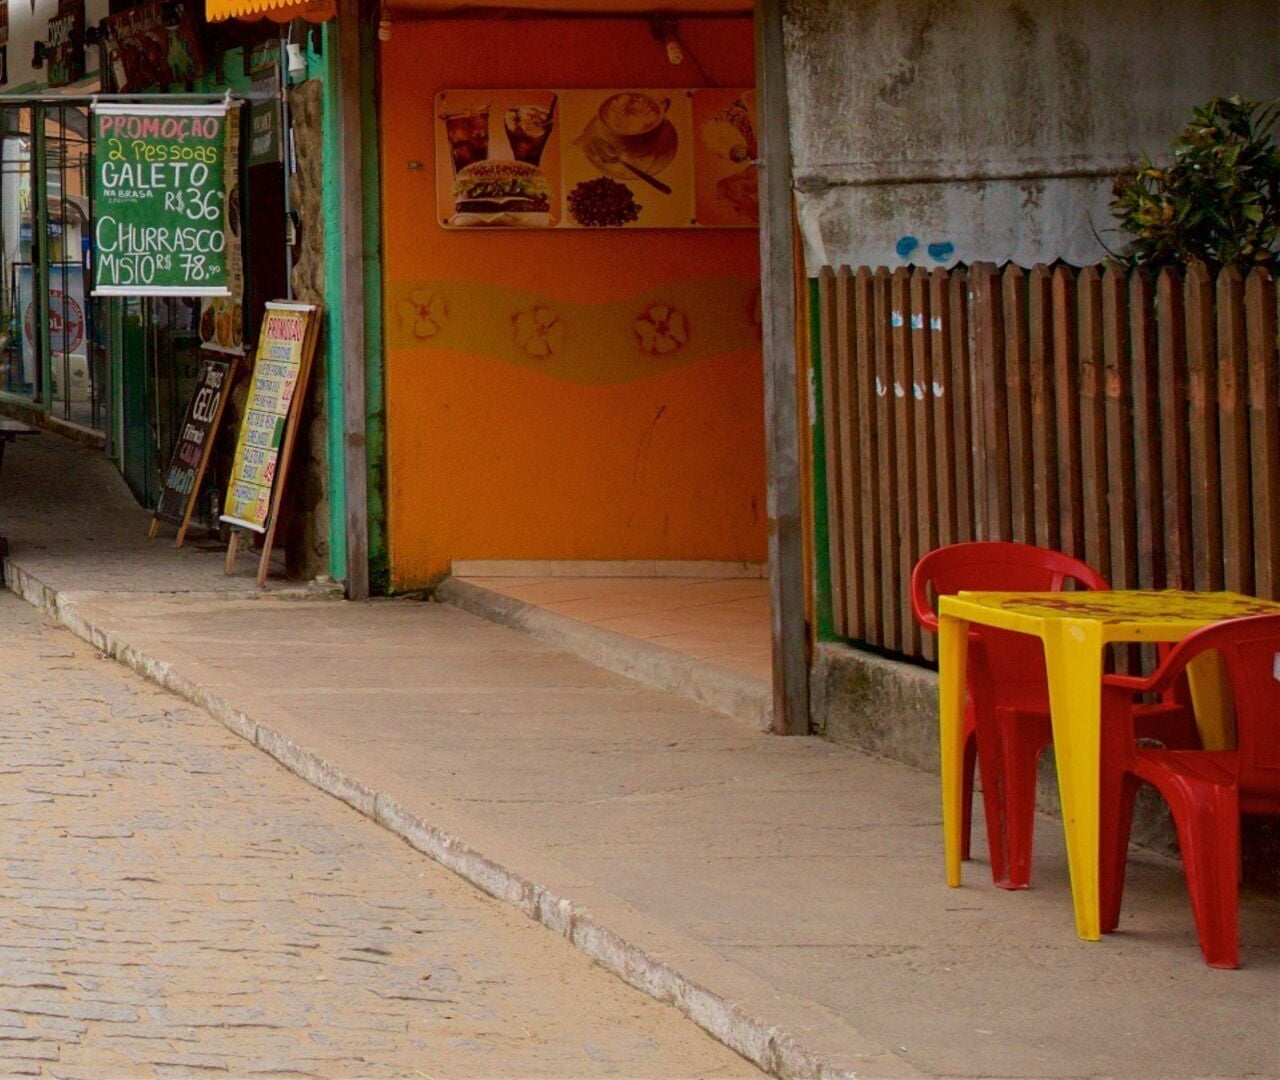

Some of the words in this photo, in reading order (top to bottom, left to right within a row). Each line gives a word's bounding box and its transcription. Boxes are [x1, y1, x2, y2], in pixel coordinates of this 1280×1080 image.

[99, 114, 220, 144] PROMOÇÃO
[108, 137, 127, 161] 2
[131, 139, 218, 164] Pessoas
[101, 161, 210, 189] GALETO
[165, 190, 185, 215] R$
[95, 215, 226, 254] CHURRASCO
[95, 252, 156, 285] MISTO
[155, 253, 173, 271] R$
[192, 386, 222, 424] GELO
